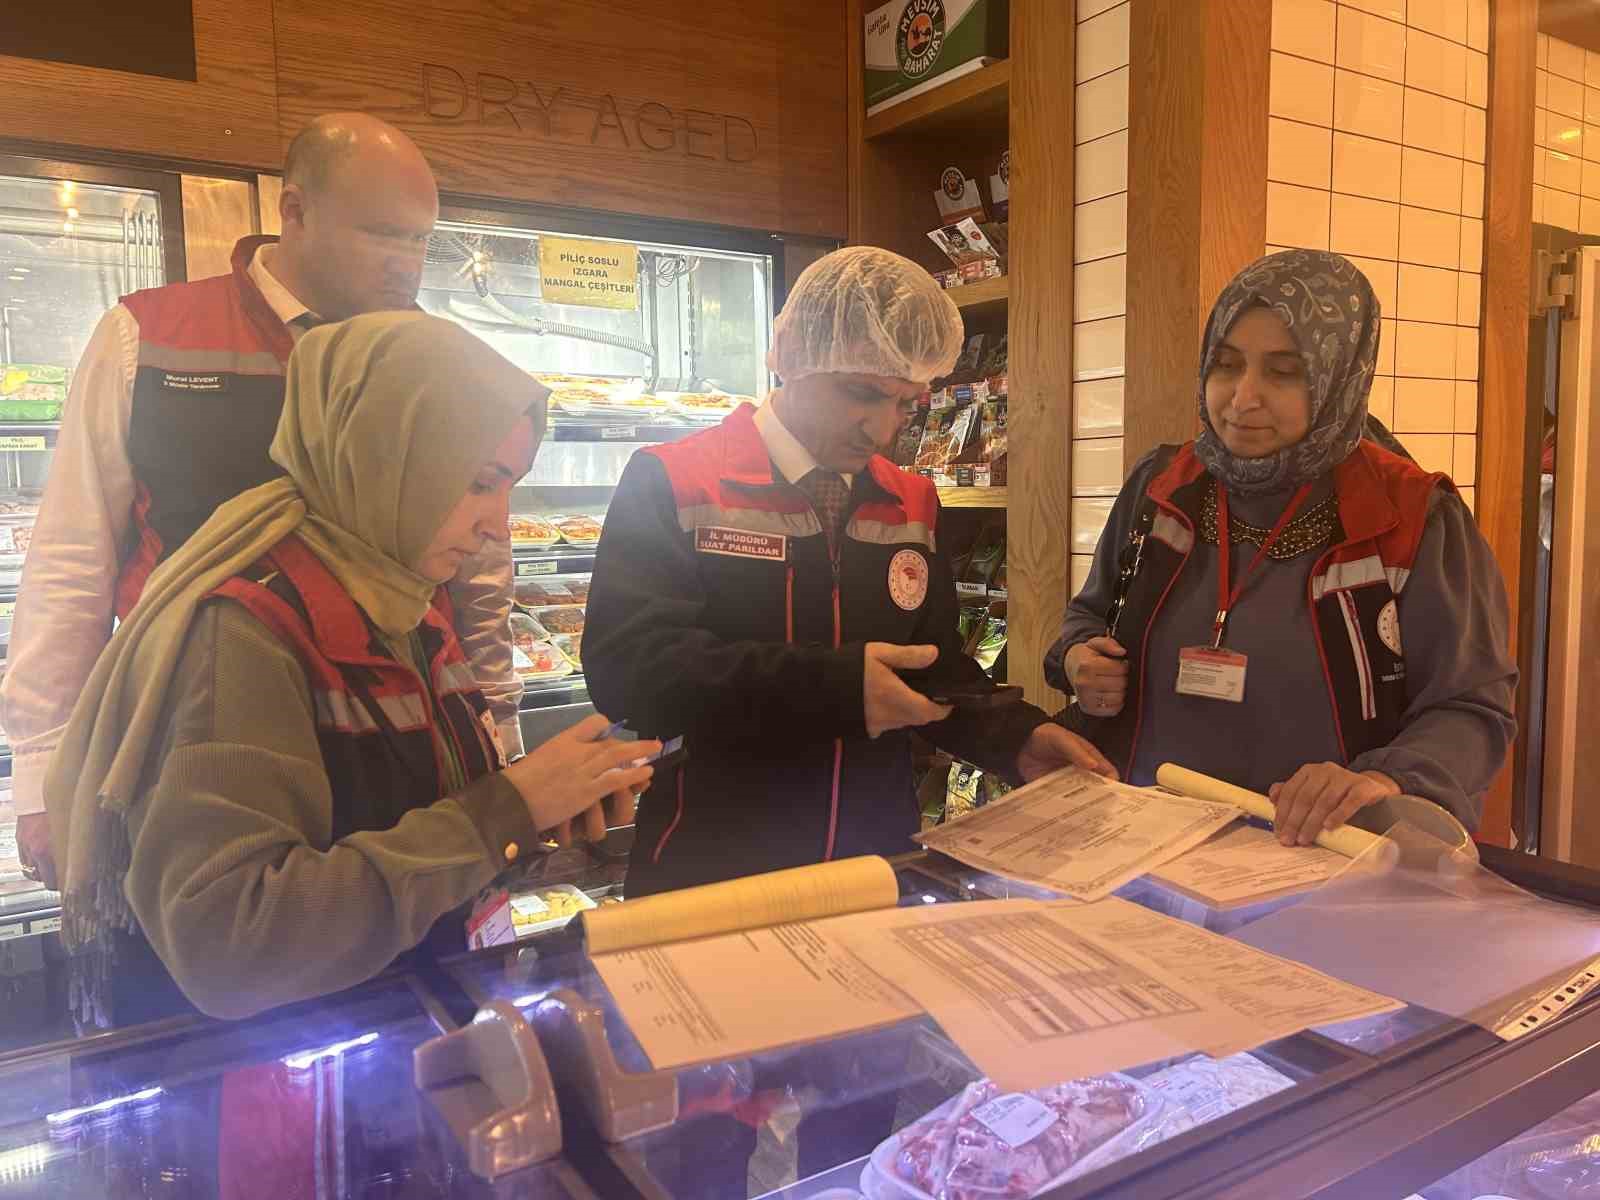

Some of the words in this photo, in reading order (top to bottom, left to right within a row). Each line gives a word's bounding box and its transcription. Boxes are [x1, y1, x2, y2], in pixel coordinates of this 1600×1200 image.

[903, 30, 942, 73] BAHARAT
[422, 62, 564, 136] DRY
[590, 93, 759, 163] AGED
[560, 252, 585, 265] PİLİÇ
[588, 256, 619, 267] SOSLU
[572, 267, 608, 278] IZGARA
[544, 278, 586, 289] MANGAL
[588, 282, 634, 293] ÇEŞİTLERİ
